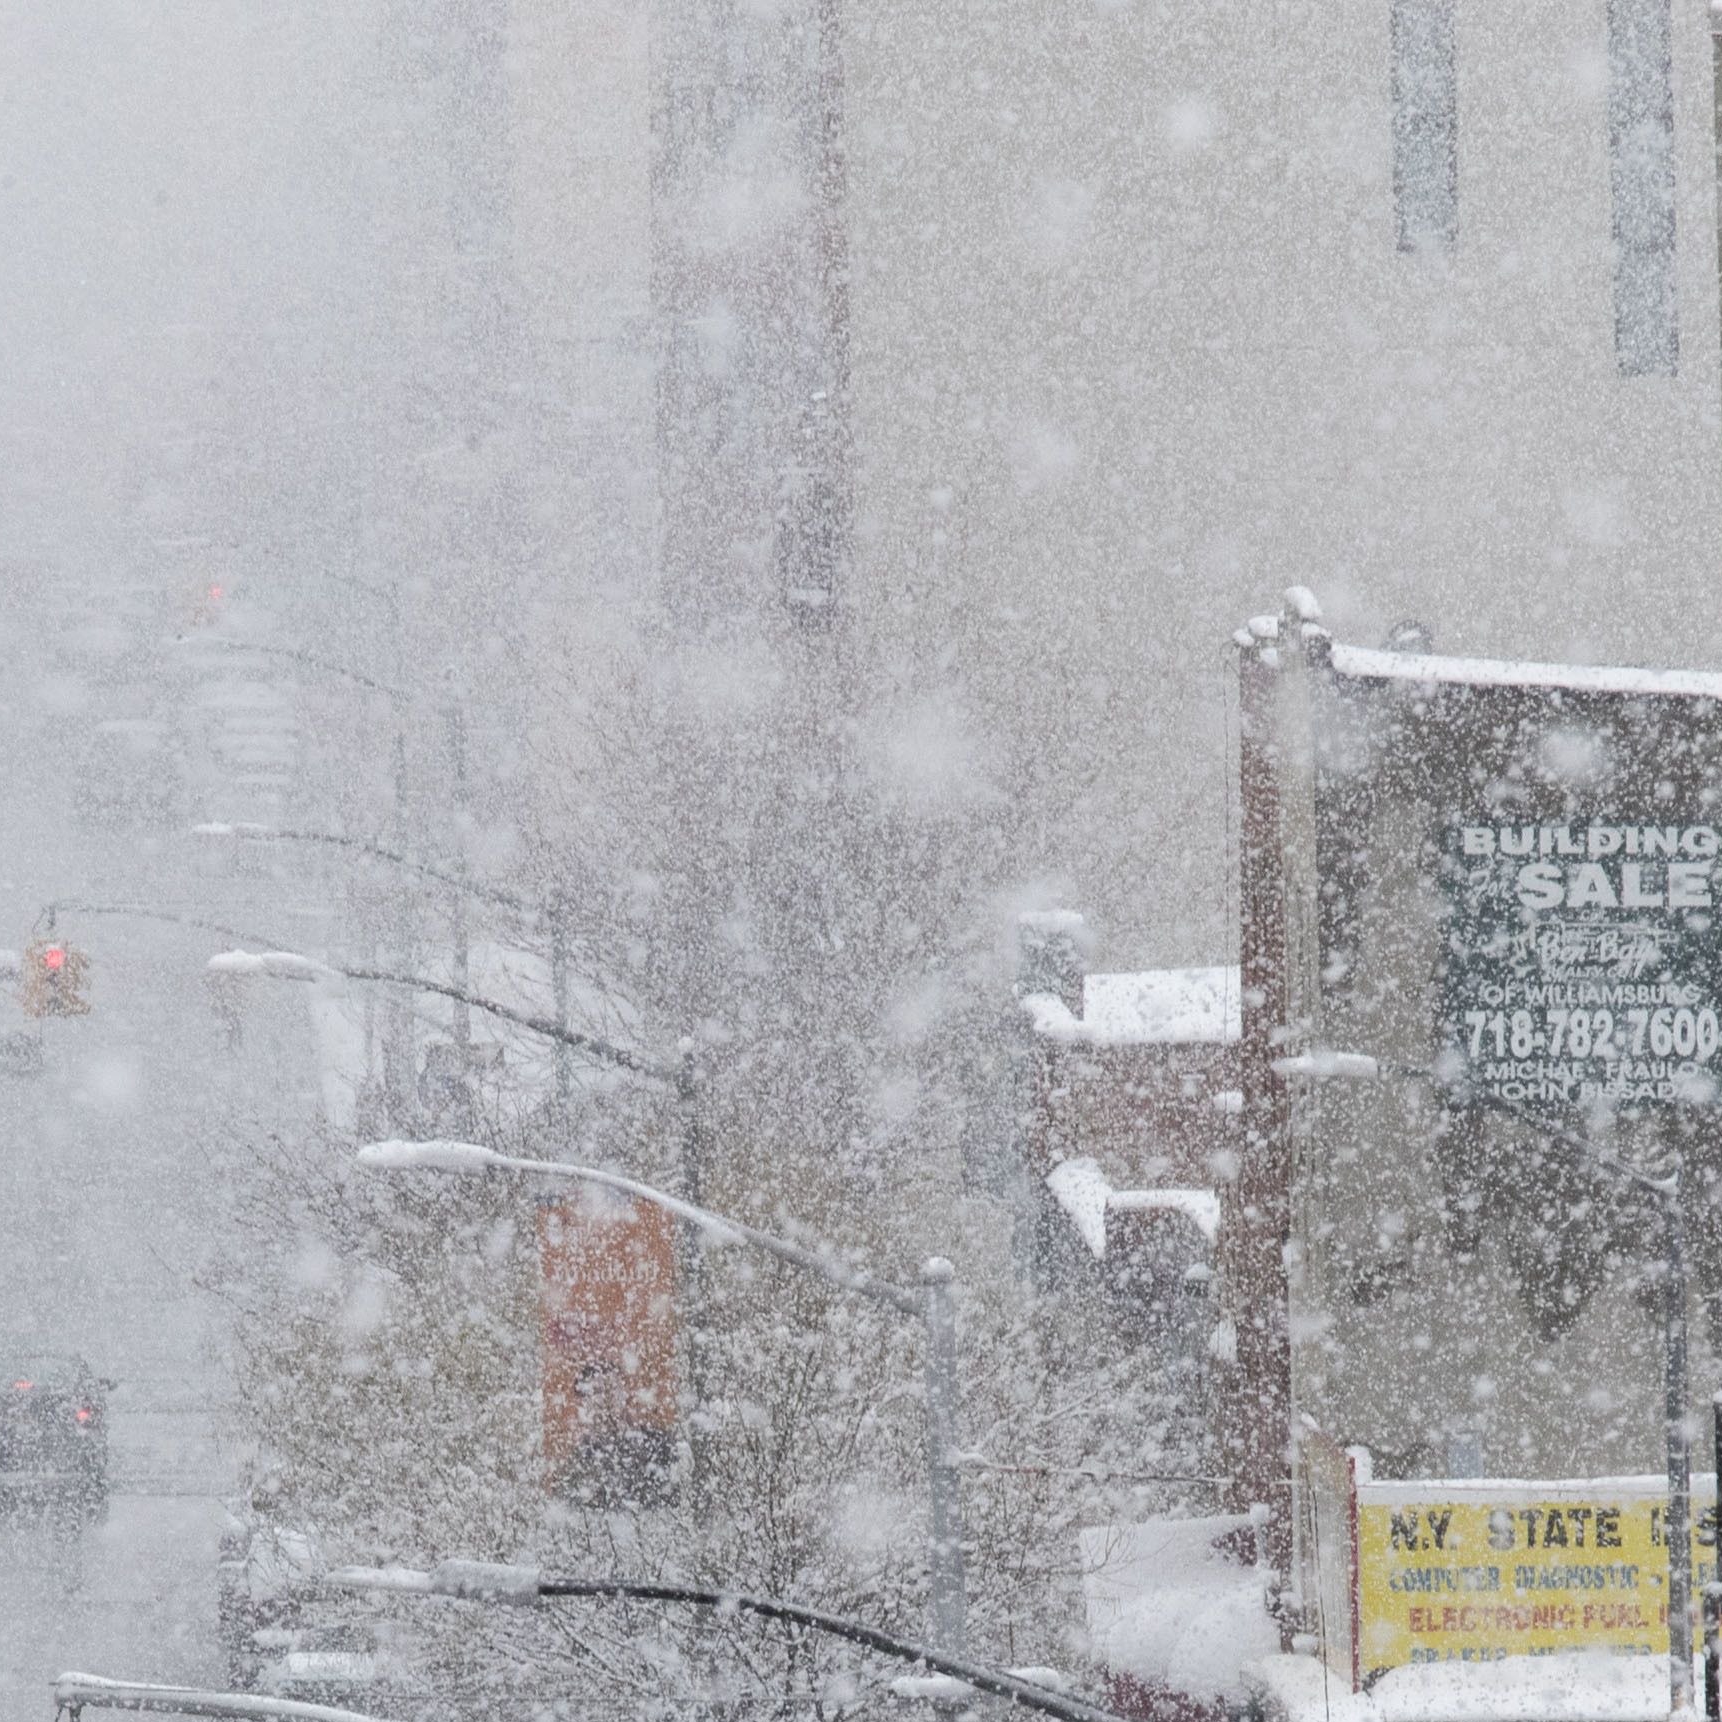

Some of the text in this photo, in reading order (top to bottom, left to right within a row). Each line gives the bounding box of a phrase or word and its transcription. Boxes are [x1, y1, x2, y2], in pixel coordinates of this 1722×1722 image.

[1463, 825, 1719, 855] BUILDING
[1518, 861, 1715, 909] SALE
[1482, 984, 1702, 1005] OF WILLIAMSBURG
[1579, 1080, 1692, 1101] BISSAD
[1487, 1506, 1622, 1550] STATE
[1388, 1563, 1640, 1593] COMPUTER DIAGNOSTIC
[1408, 1603, 1576, 1633] ELECTRONIC
[1582, 1602, 1650, 1630] FUEL
